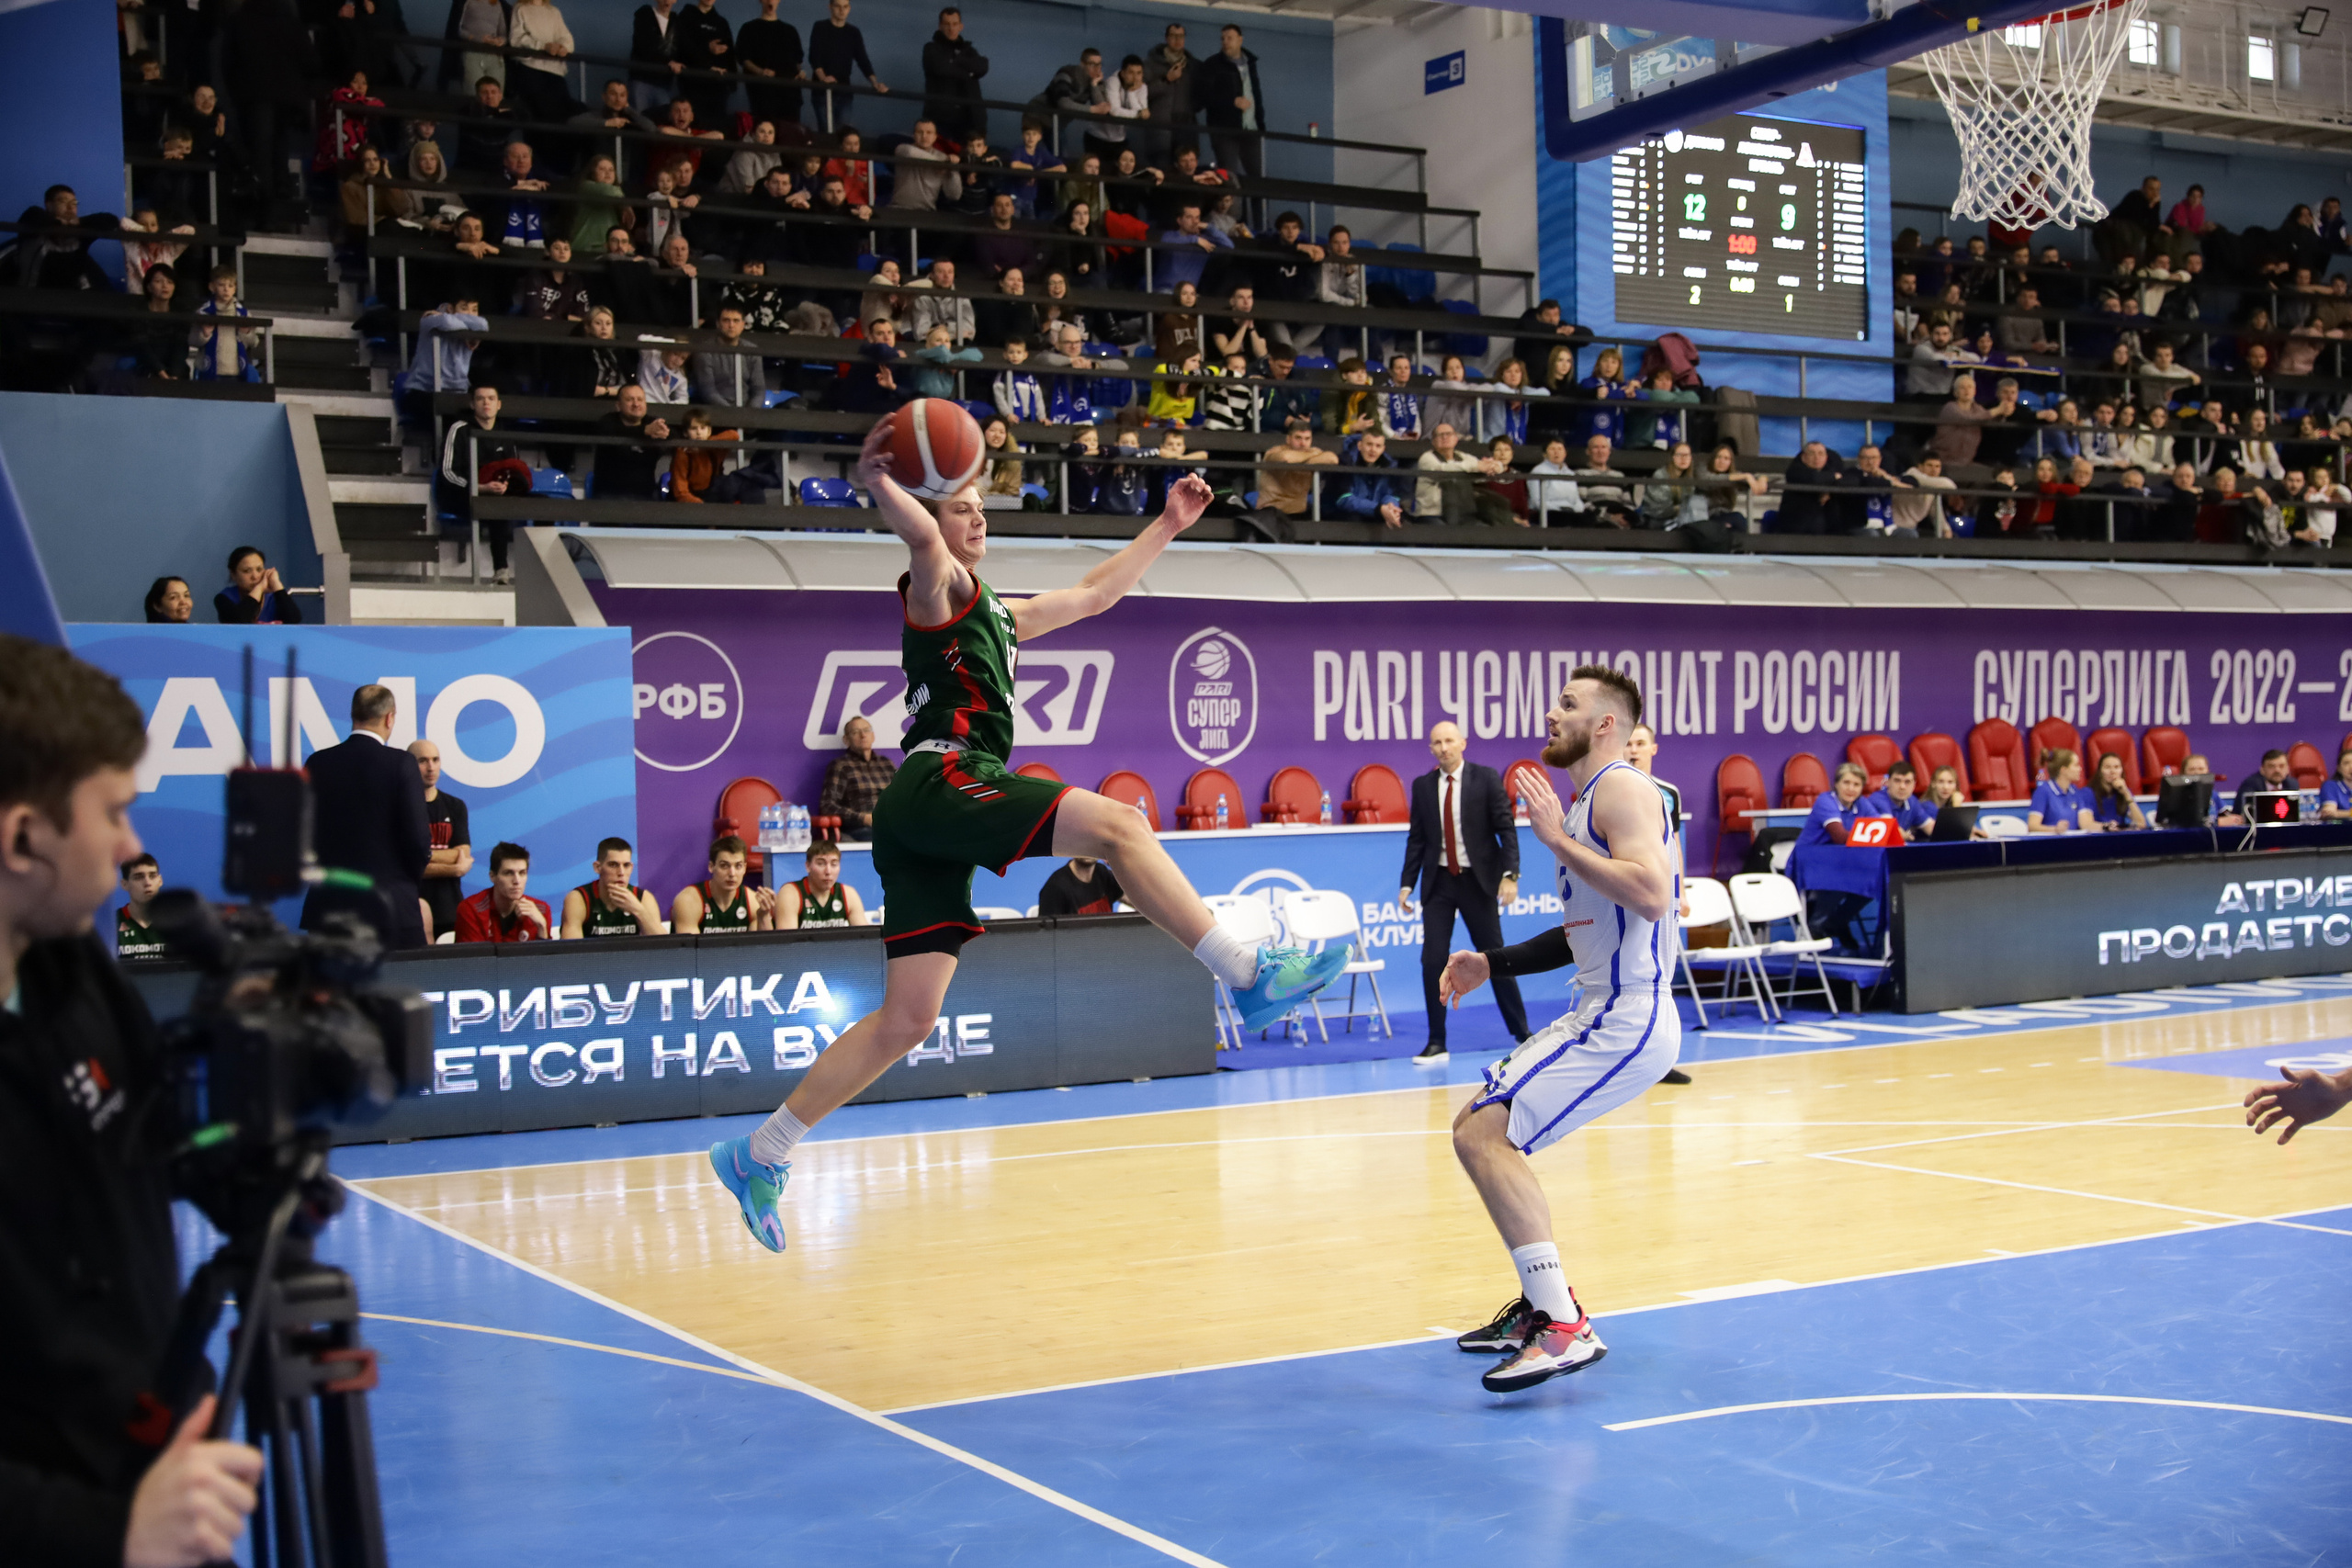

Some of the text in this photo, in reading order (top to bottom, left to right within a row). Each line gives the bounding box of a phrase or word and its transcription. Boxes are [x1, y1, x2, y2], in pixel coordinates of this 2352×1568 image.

[1683, 193, 1707, 221] 12
[1781, 204, 1796, 231] 9
[1689, 285, 1702, 305] 2
[1784, 293, 1793, 312] 1
[633, 682, 727, 720] РФБ
[818, 661, 1100, 737] PRI
[1313, 649, 1424, 741] PARI
[1440, 649, 1723, 740] ЧЕМПНАТ
[1735, 649, 1901, 735] РОССИИ
[1973, 649, 2191, 728] СУПЕРЛИГА
[1187, 698, 1241, 728] СУПЕР
[1198, 728, 1229, 750] ЛИГА
[1852, 820, 1887, 843] 5
[119, 942, 165, 955] ЛОКОМОТ
[2098, 913, 2352, 964] ПРОДАЕТС
[1700, 970, 2352, 1043] VLADIVO
[419, 1013, 994, 1095] ЕТСЯ НА ВДЕ
